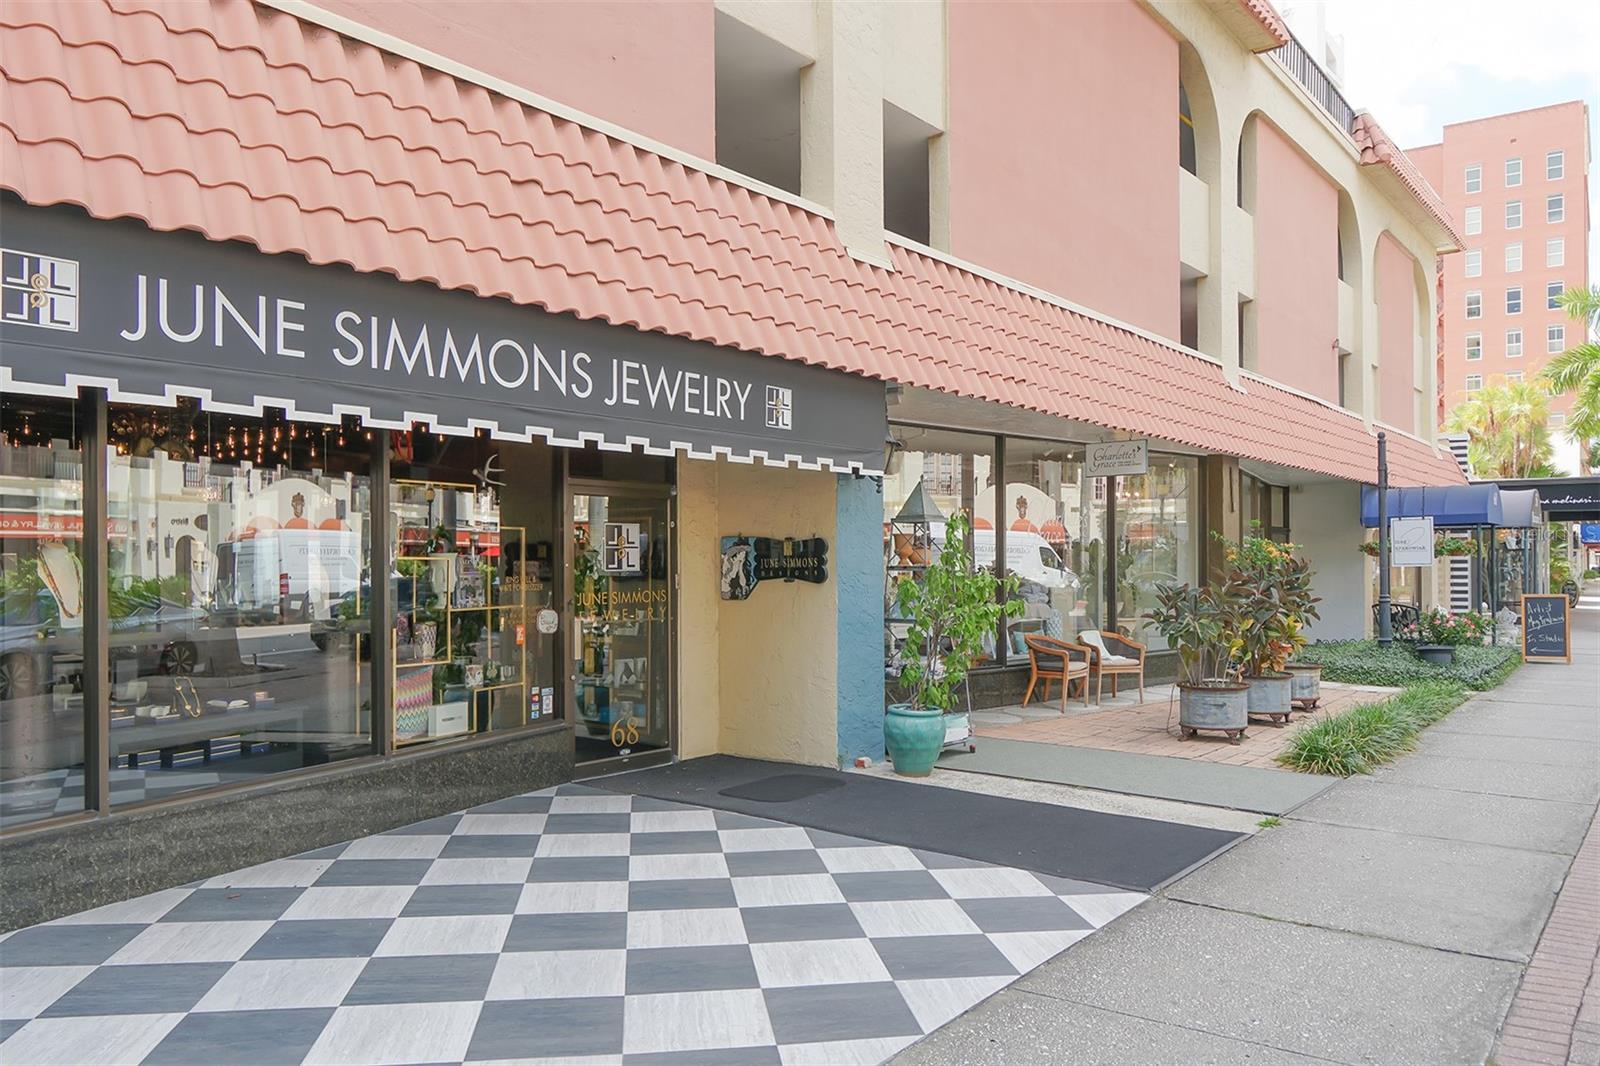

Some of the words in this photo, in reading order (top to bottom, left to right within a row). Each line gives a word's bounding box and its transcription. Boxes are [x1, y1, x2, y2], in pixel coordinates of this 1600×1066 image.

[120, 274, 305, 358] JUNE
[333, 310, 593, 399] SIMMONS
[604, 358, 752, 421] JEWELRY
[1089, 460, 1115, 472] Grace
[760, 558, 778, 569] JUNE
[783, 556, 818, 569] SIMMONS
[577, 592, 608, 606] JUNE
[611, 589, 667, 604] SIMMONS
[611, 715, 639, 748] 68
